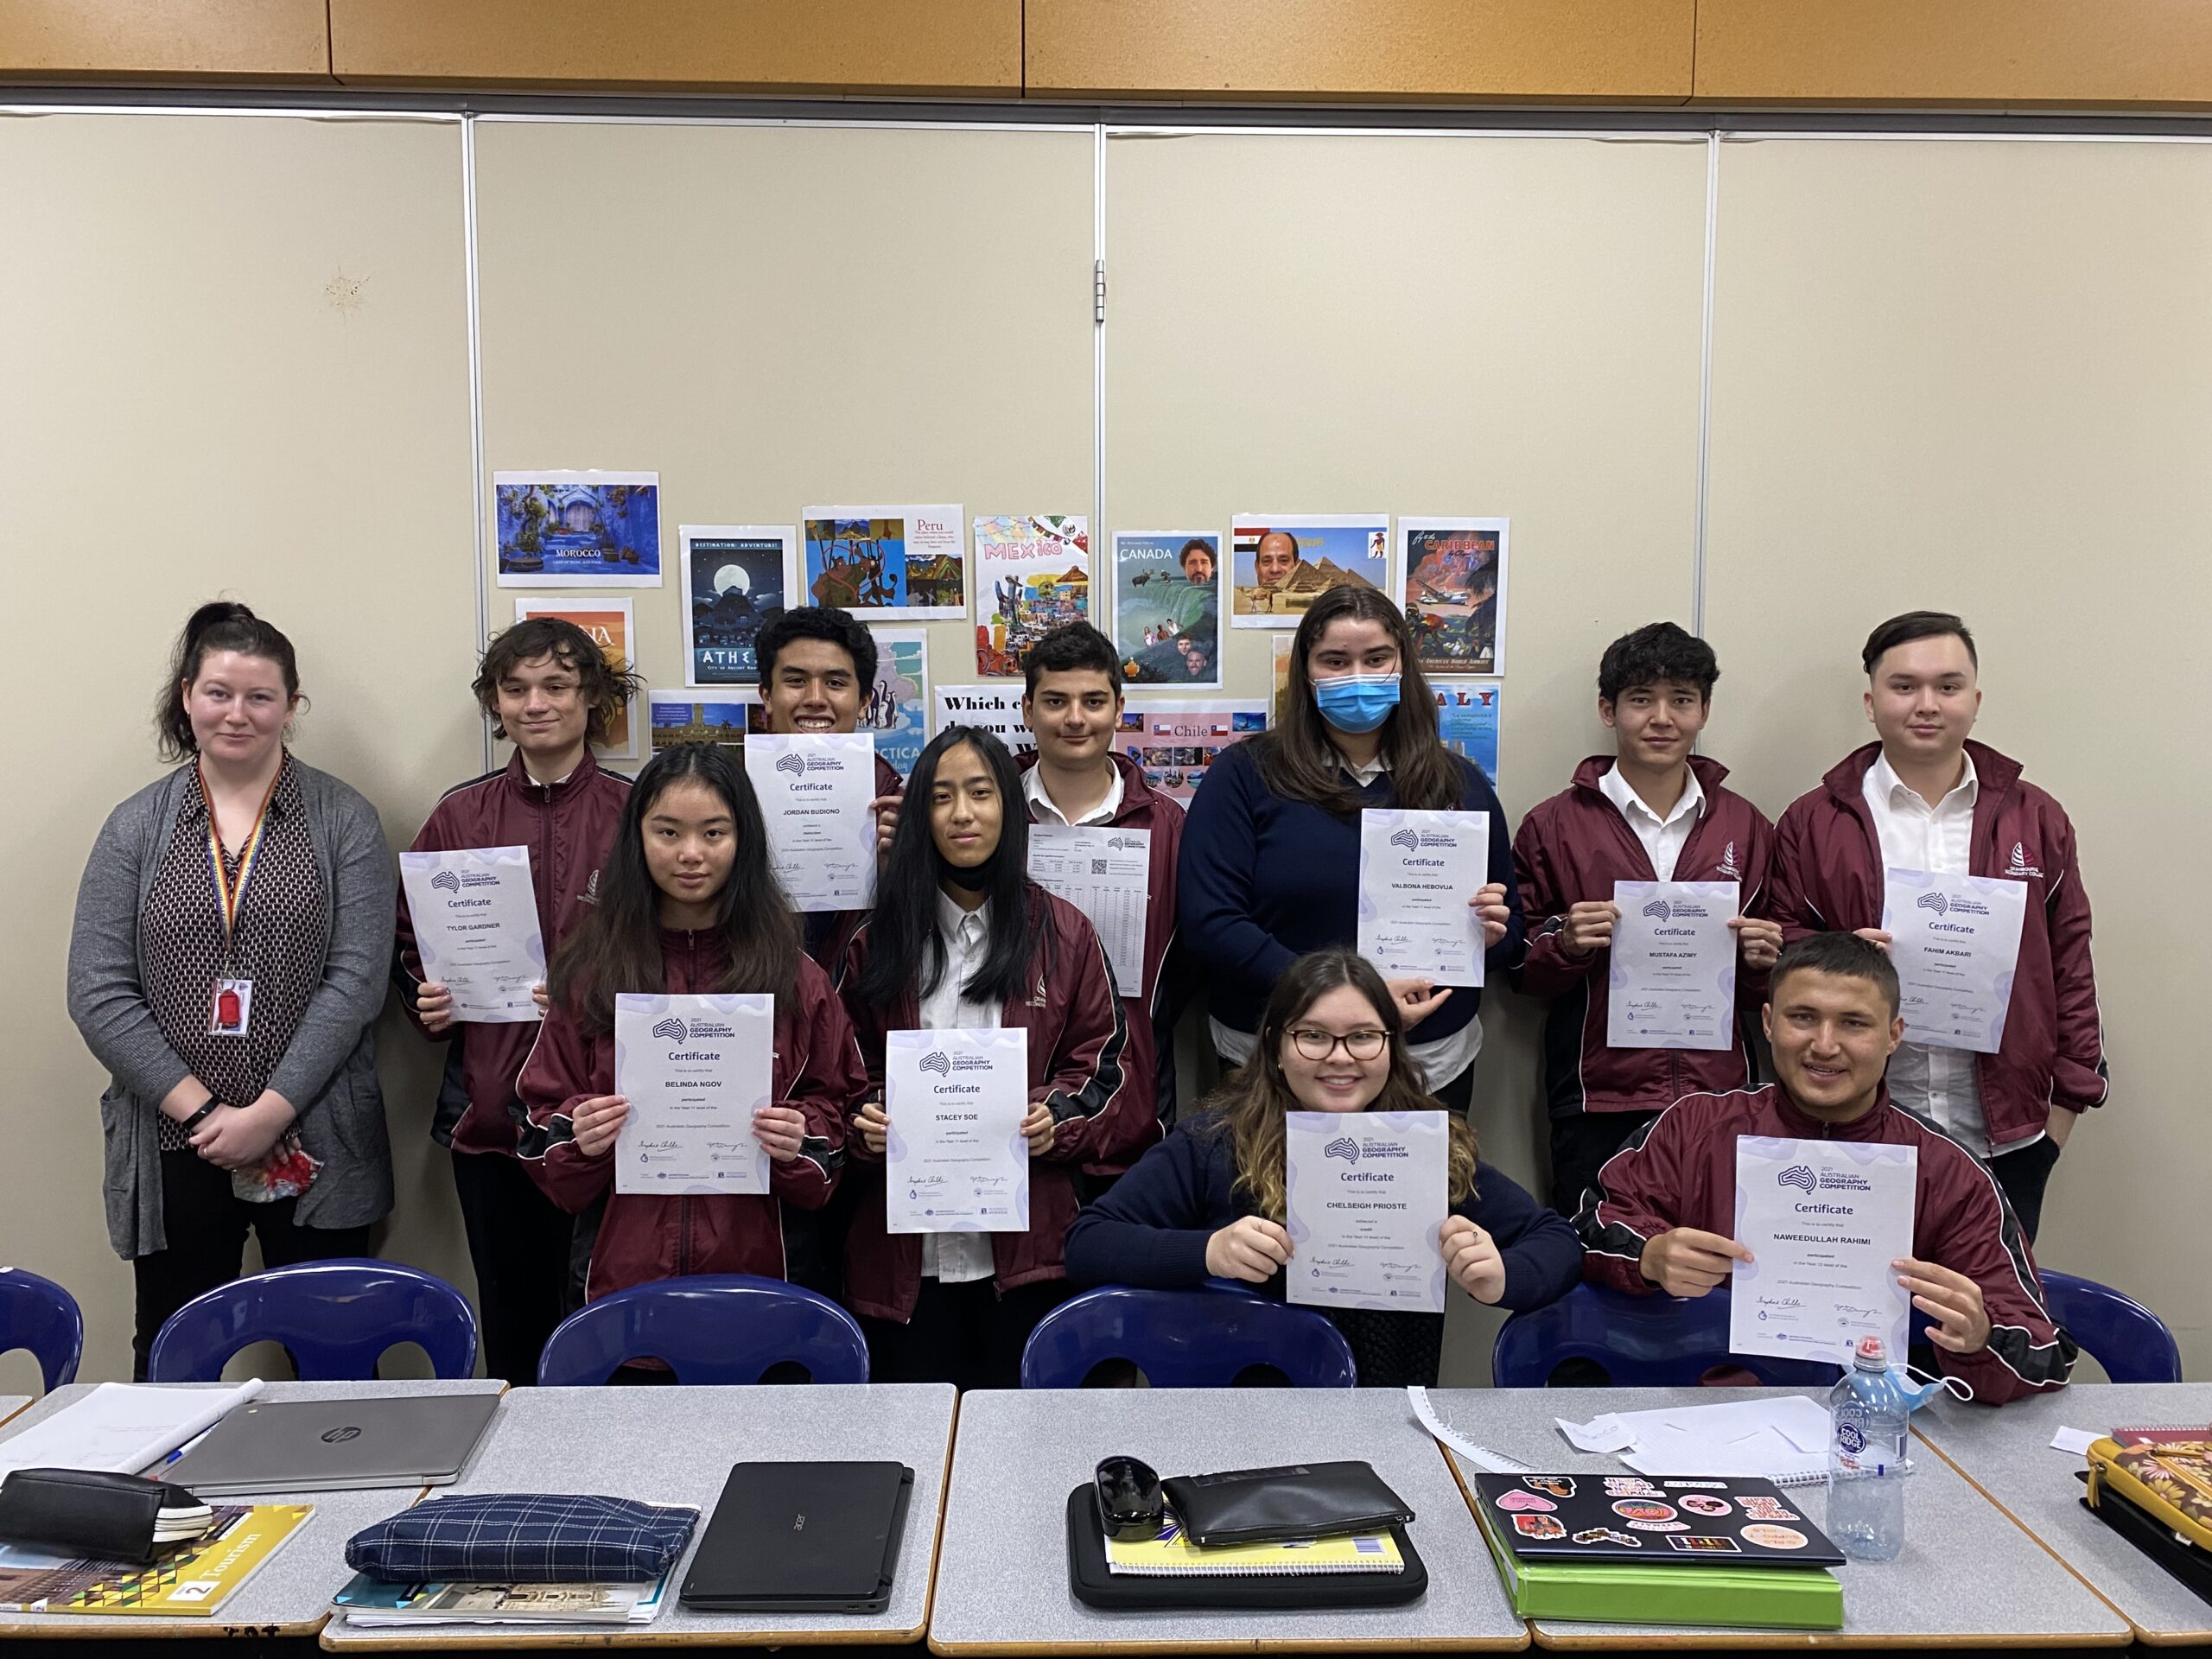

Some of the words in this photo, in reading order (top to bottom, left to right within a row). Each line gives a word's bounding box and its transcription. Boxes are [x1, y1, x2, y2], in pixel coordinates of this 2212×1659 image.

[917, 518, 944, 531] Peru
[1424, 539, 1496, 551] CARIBBEAN
[556, 549, 601, 557] MOROCCO
[1120, 549, 1173, 560] CANADA
[702, 651, 759, 664] ATHE
[944, 696, 1006, 710] Which
[1437, 692, 1495, 706] ALY
[1174, 725, 1208, 737] Chile
[790, 783, 833, 791] Certificate
[1402, 858, 1445, 867] Certificate
[448, 899, 492, 907] Certificate
[1949, 902, 1988, 911] GEOGRAPHY
[1949, 907, 1990, 916] COMPETITION
[1929, 921, 1975, 934] Certificate
[1923, 946, 1945, 955] FAHIM
[1945, 949, 1972, 958] AKBARI
[668, 1052, 721, 1061] Certificate
[933, 1084, 981, 1094] Certificate
[1340, 1173, 1395, 1182] Certificate
[1795, 1203, 1853, 1215] Certificate
[1773, 1233, 1838, 1243] NAWEEDULLAH
[1840, 1236, 1871, 1245] RAHIMI
[1841, 1427, 1859, 1440] COOL
[1840, 1433, 1862, 1449] RIDGE
[793, 1513, 805, 1531] acer
[199, 1533, 263, 1580] Tourism
[185, 1586, 212, 1595] 2
